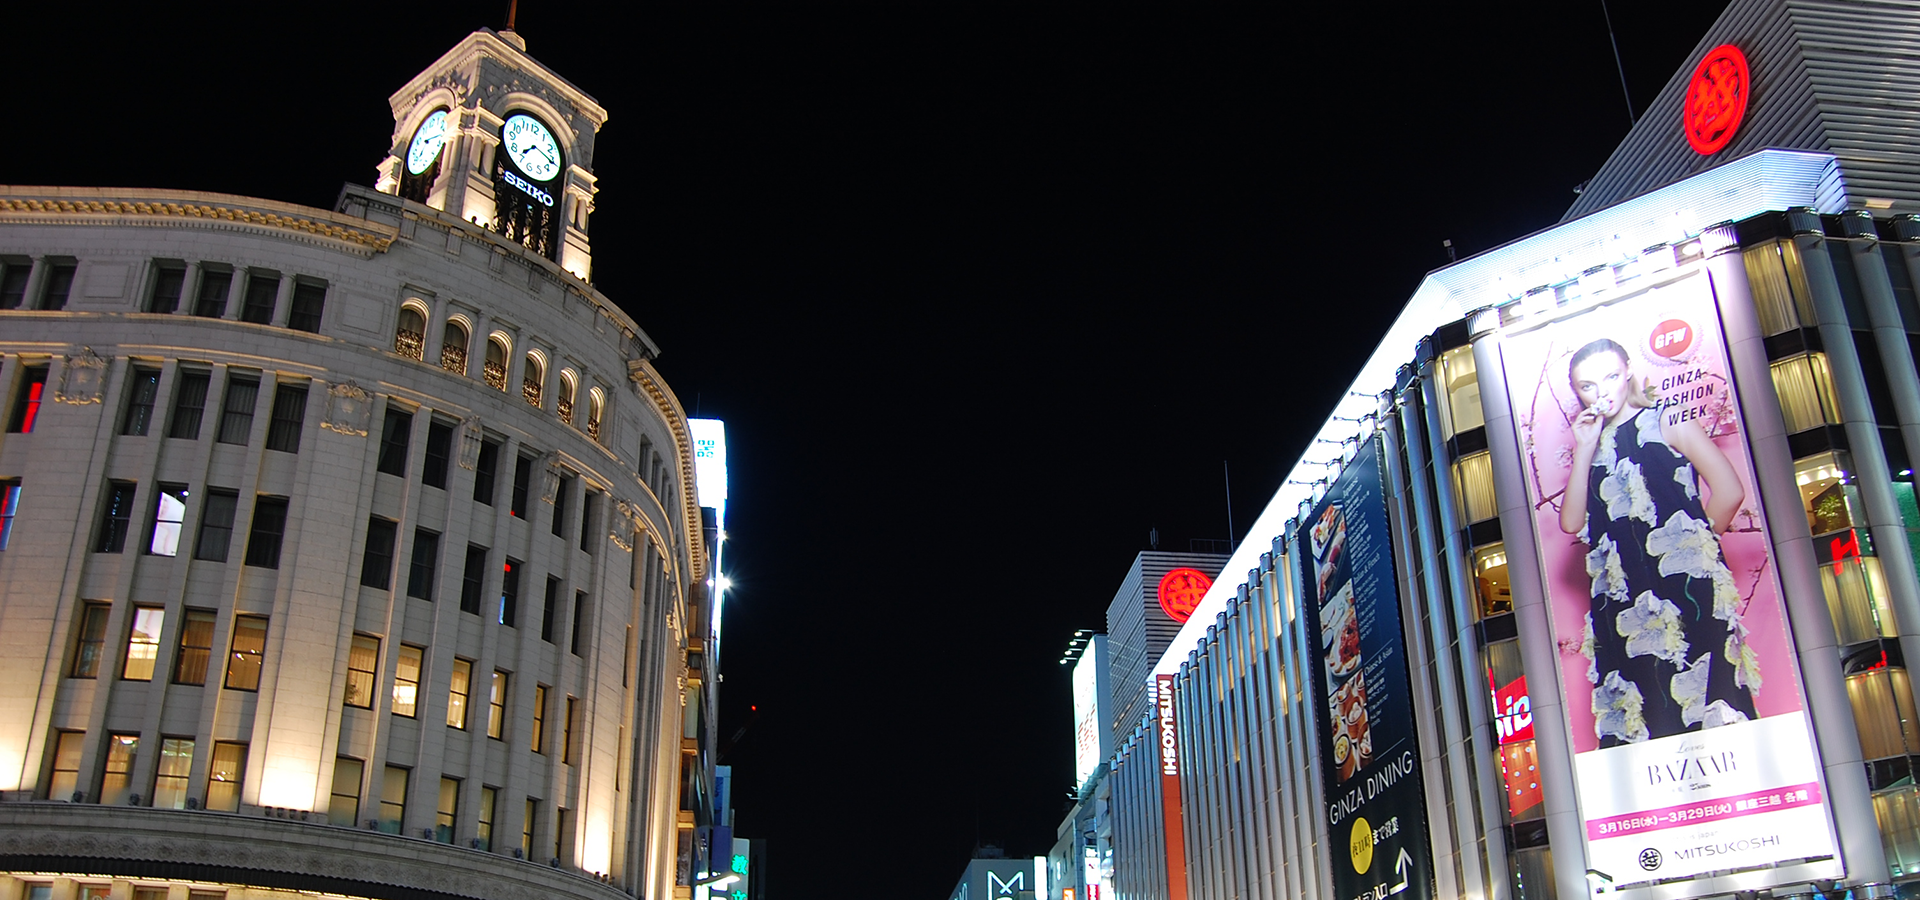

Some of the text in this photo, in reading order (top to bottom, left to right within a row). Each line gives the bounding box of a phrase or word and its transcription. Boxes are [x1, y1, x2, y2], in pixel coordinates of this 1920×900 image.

[509, 131, 516, 141] 9
[513, 122, 521, 134] 10
[510, 142, 518, 153] 8
[504, 170, 554, 207] SEIKO
[1654, 327, 1687, 350] GFW
[1661, 368, 1702, 391] GINZA
[1655, 383, 1715, 411] FASHION
[1668, 404, 1708, 426] WEEK
[1159, 680, 1177, 776] MITSUKOSHI
[1647, 751, 1737, 786] BAZAAR
[1329, 751, 1413, 825] GINZA DINING
[1674, 834, 1780, 860] MITSUKOSHI
